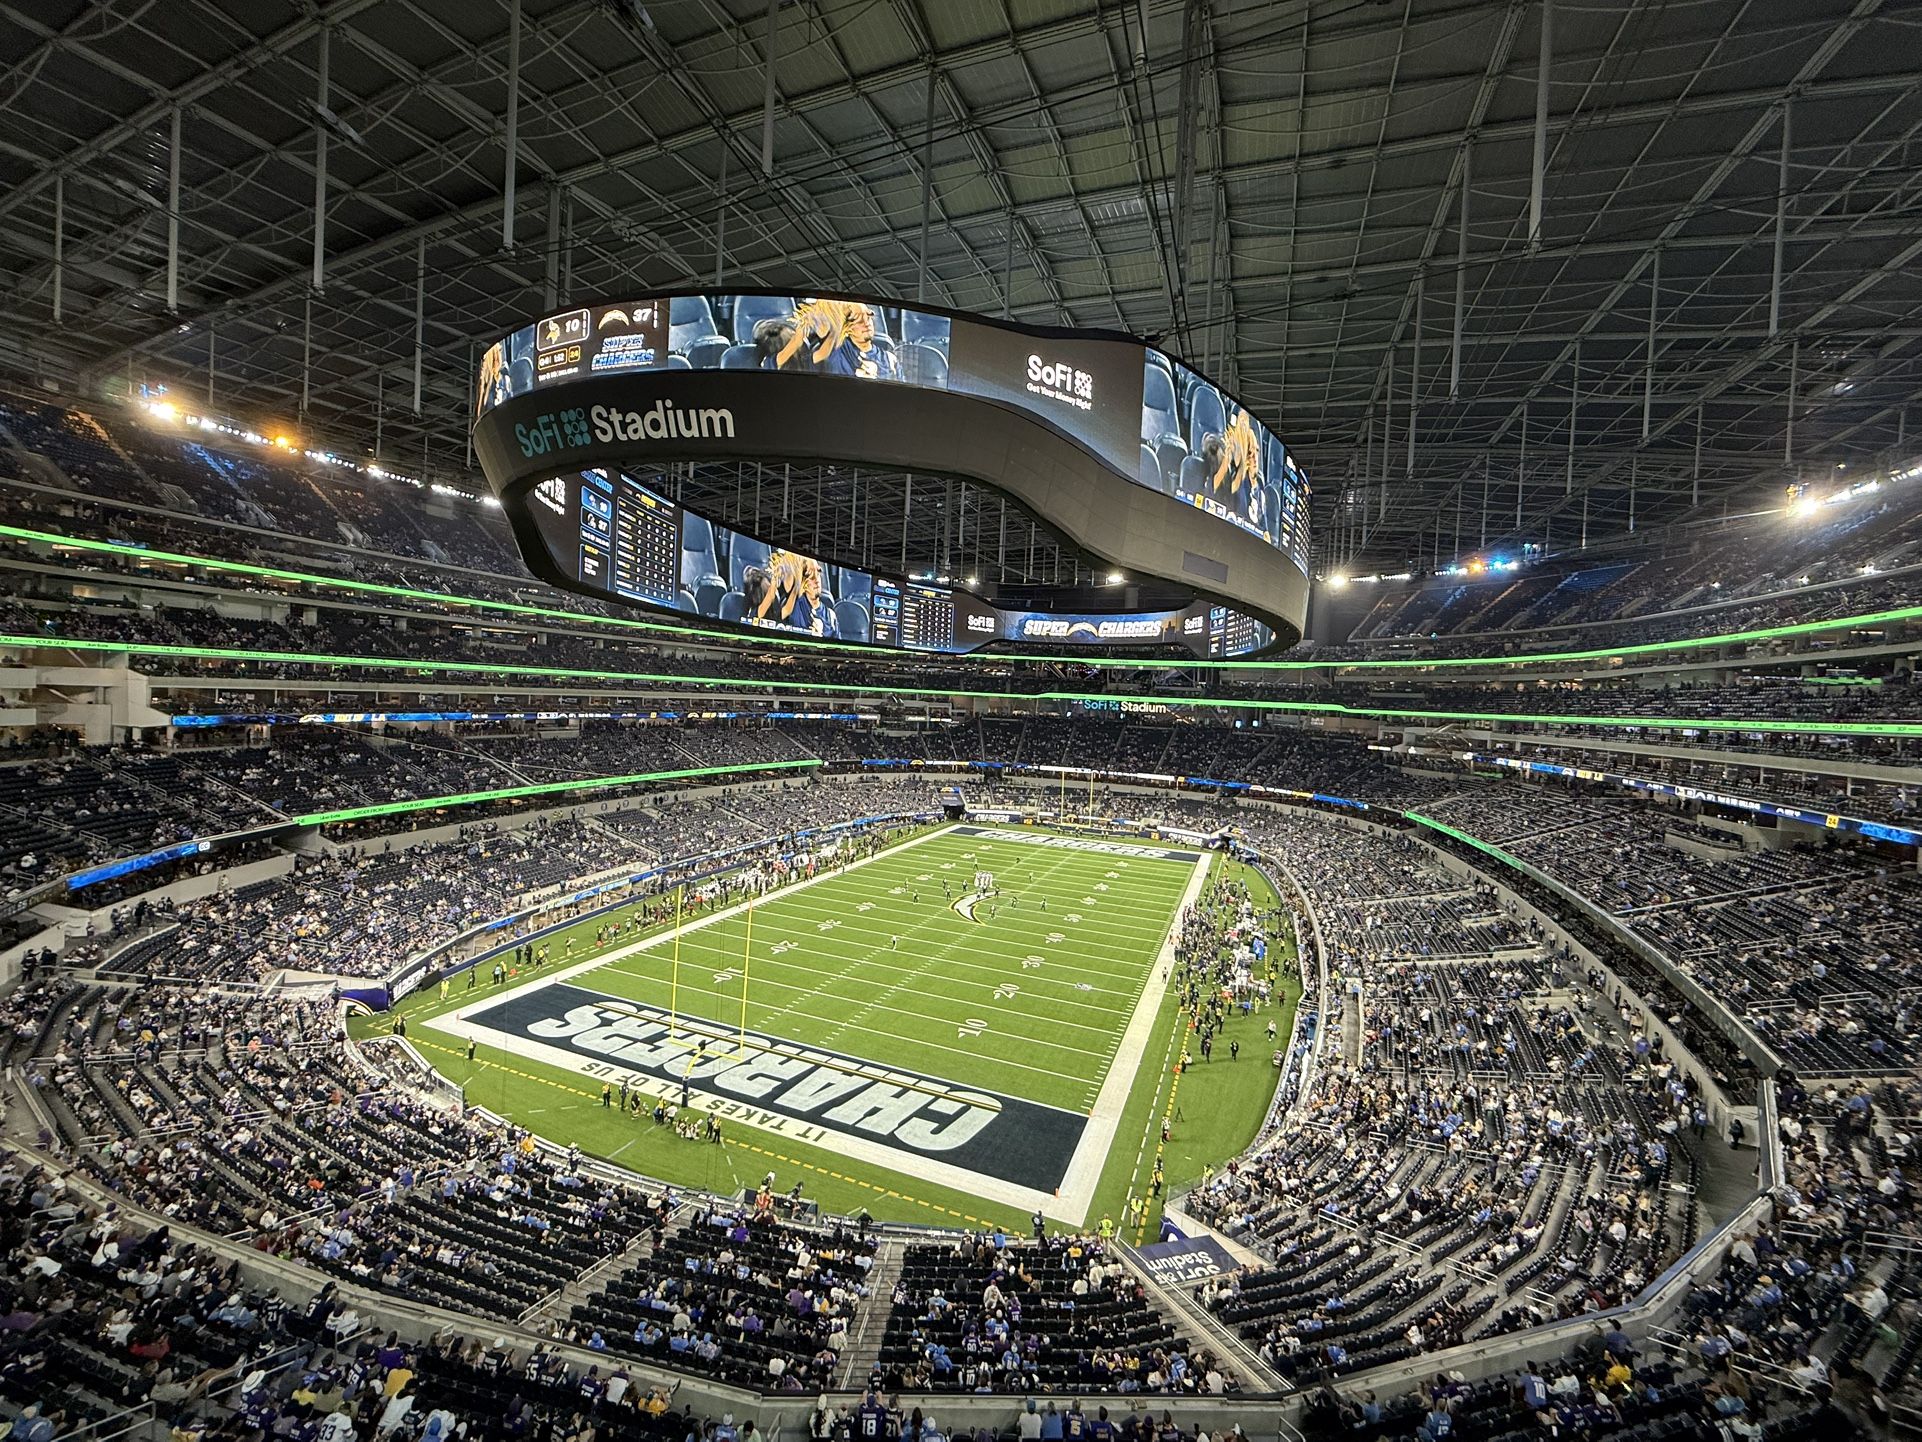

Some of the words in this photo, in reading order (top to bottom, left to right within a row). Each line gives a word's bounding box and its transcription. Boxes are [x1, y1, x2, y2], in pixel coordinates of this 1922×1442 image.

[632, 308, 652, 322] 37
[565, 318, 580, 333] 10
[1027, 354, 1073, 392] SoFi
[1026, 382, 1041, 393] Get
[1040, 385, 1056, 398] Your
[514, 414, 564, 457] SoFi
[590, 399, 735, 443] Stadium
[967, 614, 986, 628] SoFi
[1023, 620, 1069, 637] SUPER
[1098, 620, 1163, 637] CHARGERS
[1083, 699, 1108, 711] SoFi
[1120, 701, 1167, 714] Stadium
[974, 829, 1171, 859] CHARGERS
[1021, 954, 1045, 969] 30
[713, 966, 745, 984] 10
[993, 983, 1020, 1000] 20
[957, 1018, 988, 1039] 10
[526, 999, 1002, 1151] CHARGERS
[580, 1061, 615, 1077] US
[615, 1072, 651, 1088] OF
[705, 1099, 790, 1131] TAKES
[795, 1125, 828, 1142] IT
[1145, 1251, 1213, 1273] Stadium
[267, 1311, 277, 1322] 21
[965, 1373, 976, 1386] 10
[1534, 1381, 1547, 1399] 10
[862, 1419, 877, 1436] 18
[885, 1422, 898, 1437] 21
